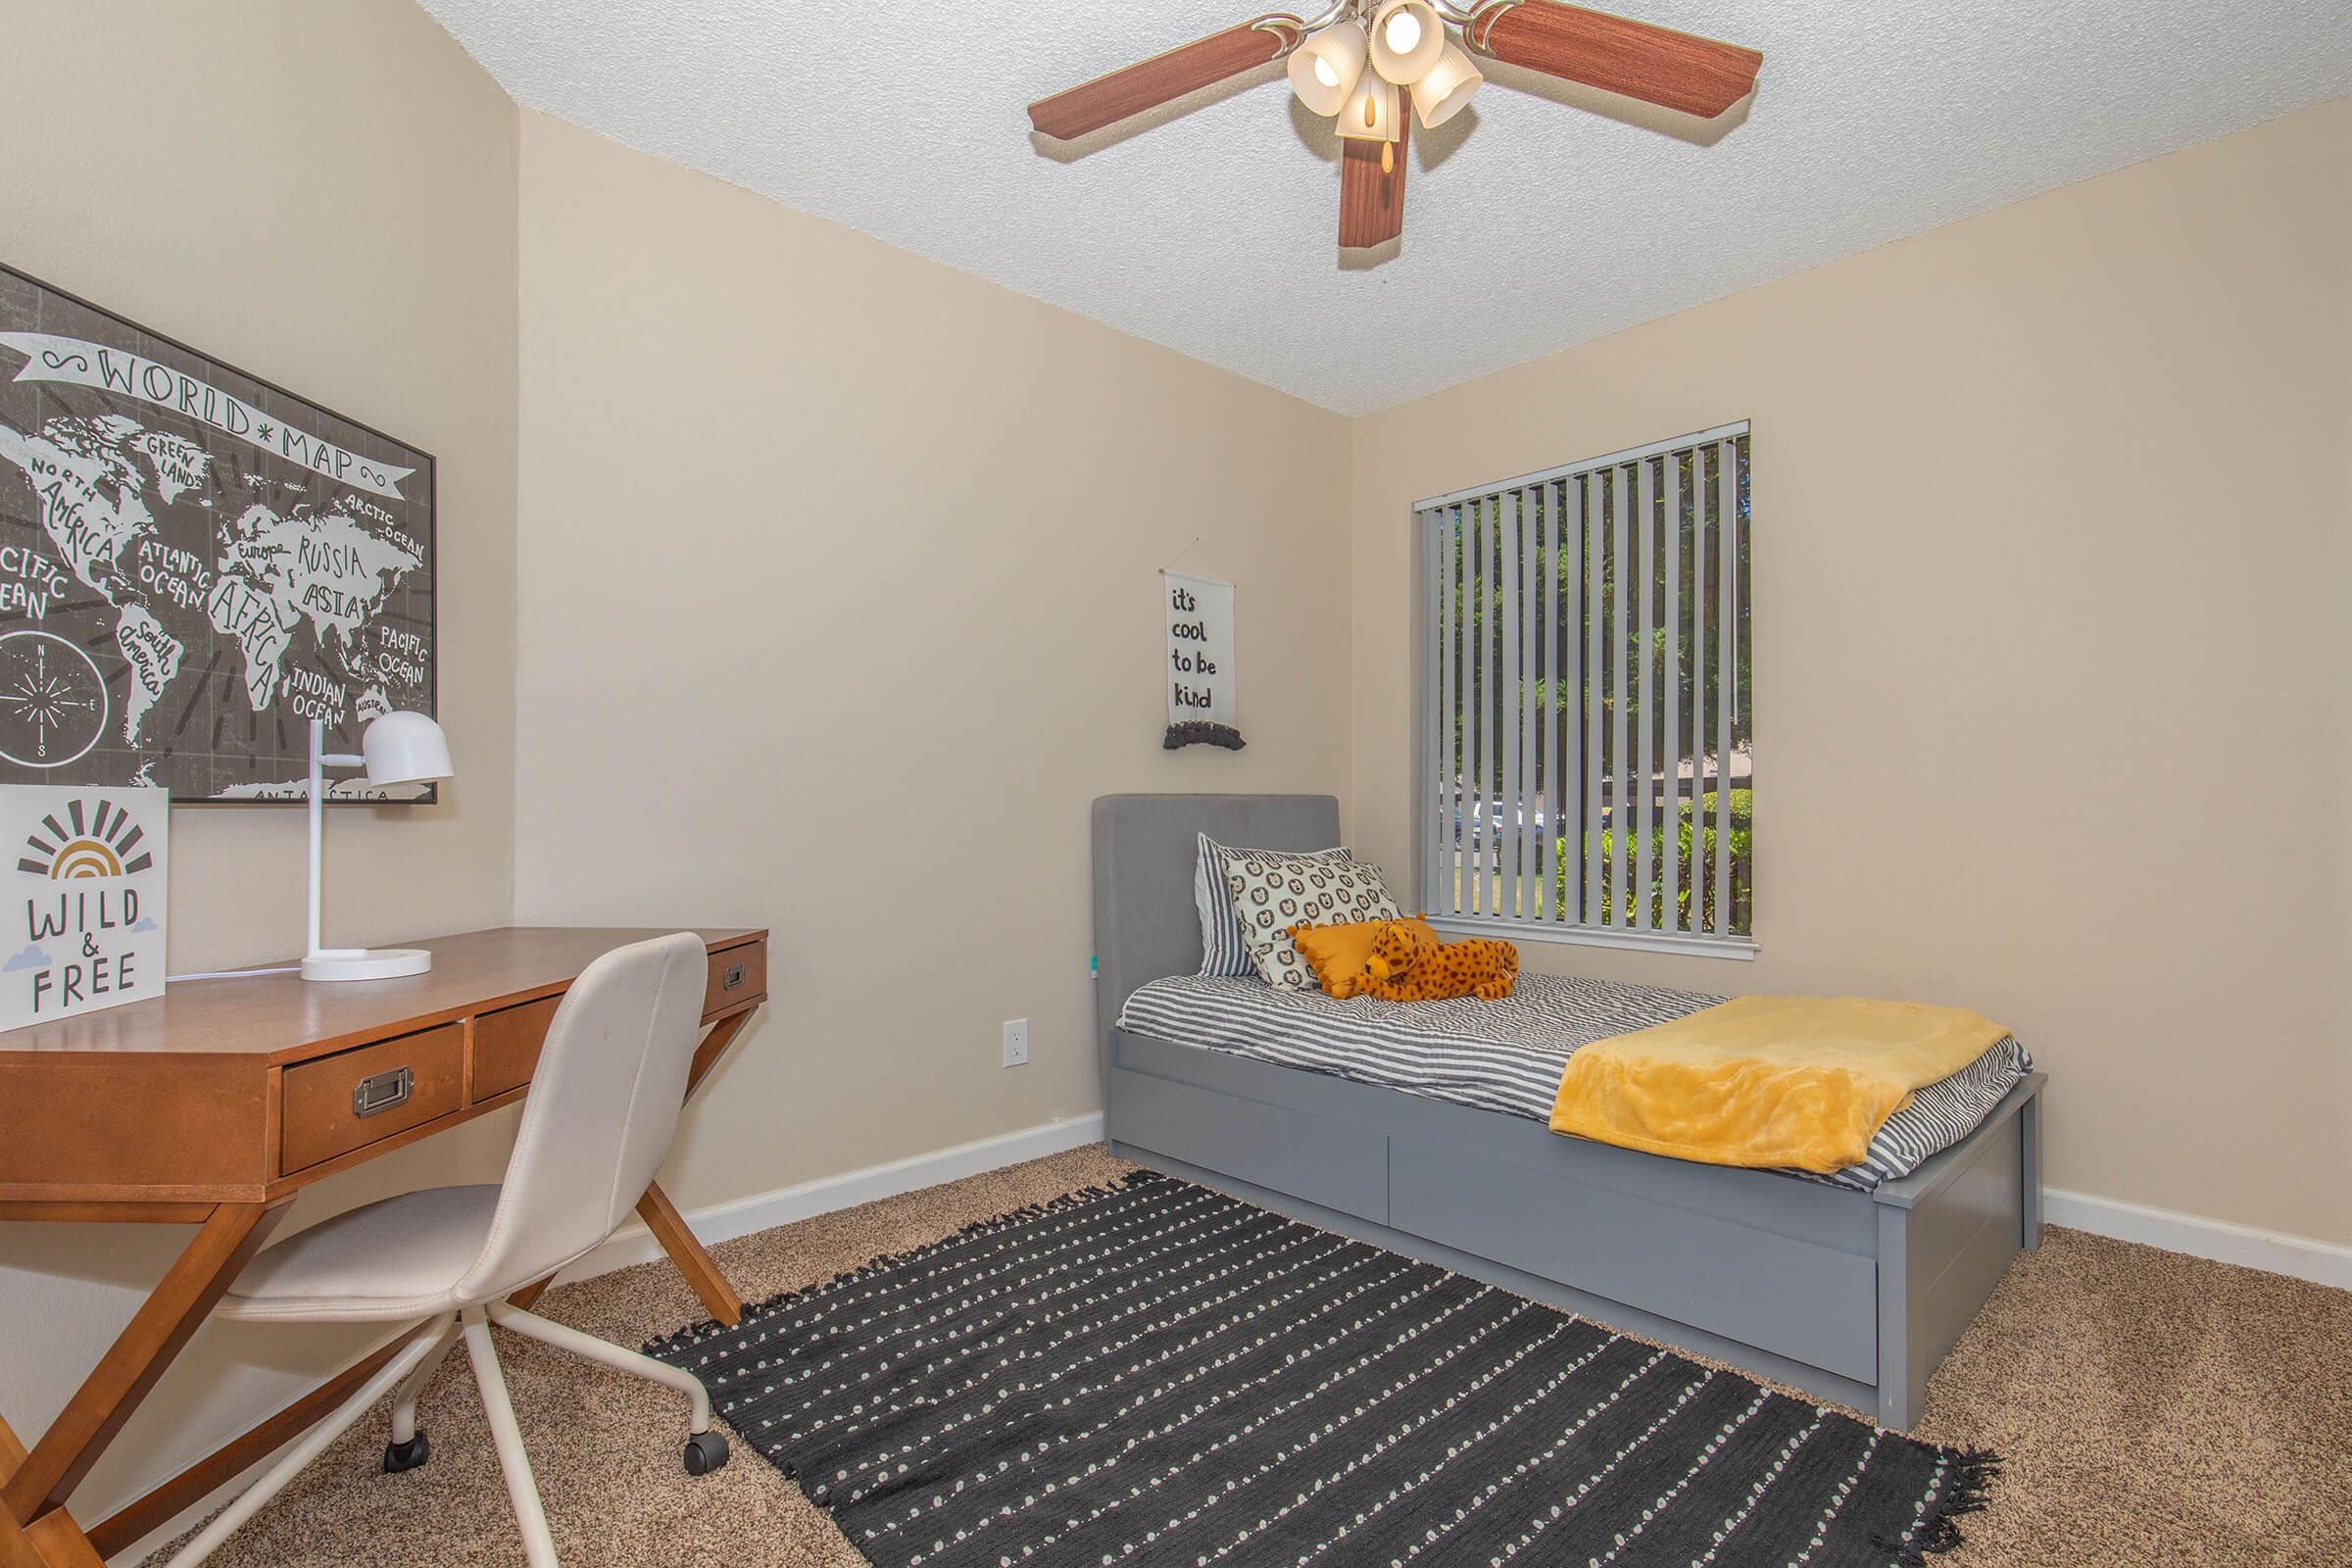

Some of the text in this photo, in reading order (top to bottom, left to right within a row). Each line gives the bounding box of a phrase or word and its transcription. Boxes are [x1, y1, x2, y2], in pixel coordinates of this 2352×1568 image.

[98, 349, 354, 479] WORLD MAP
[147, 435, 195, 467] GREEN
[31, 457, 96, 502] NORTH
[41, 481, 114, 564] AMERICA
[345, 493, 394, 526] ARCTIC
[298, 535, 367, 579] RUSSIA
[385, 526, 424, 562] OCEAN
[138, 540, 211, 589] ATLANTIC
[140, 564, 207, 610] OCEAN
[303, 583, 361, 620] ASIA
[1172, 588, 1197, 612] it's
[210, 579, 278, 707] AFRICA
[379, 625, 428, 662] PACIFIC
[1172, 621, 1207, 642] cool
[37, 644, 45, 656] N
[1172, 648, 1217, 675] to be
[291, 666, 347, 709] INDIAN
[379, 652, 425, 687] OCEAN
[89, 699, 96, 711] E
[293, 694, 346, 730] OCEAN
[357, 699, 390, 715] AUSTRAL
[1175, 683, 1212, 709] kind
[37, 745, 46, 758] S
[255, 789, 389, 801] ANTACTICA
[27, 888, 139, 942] WILD
[82, 931, 100, 957] &
[33, 951, 135, 1013] FREE
